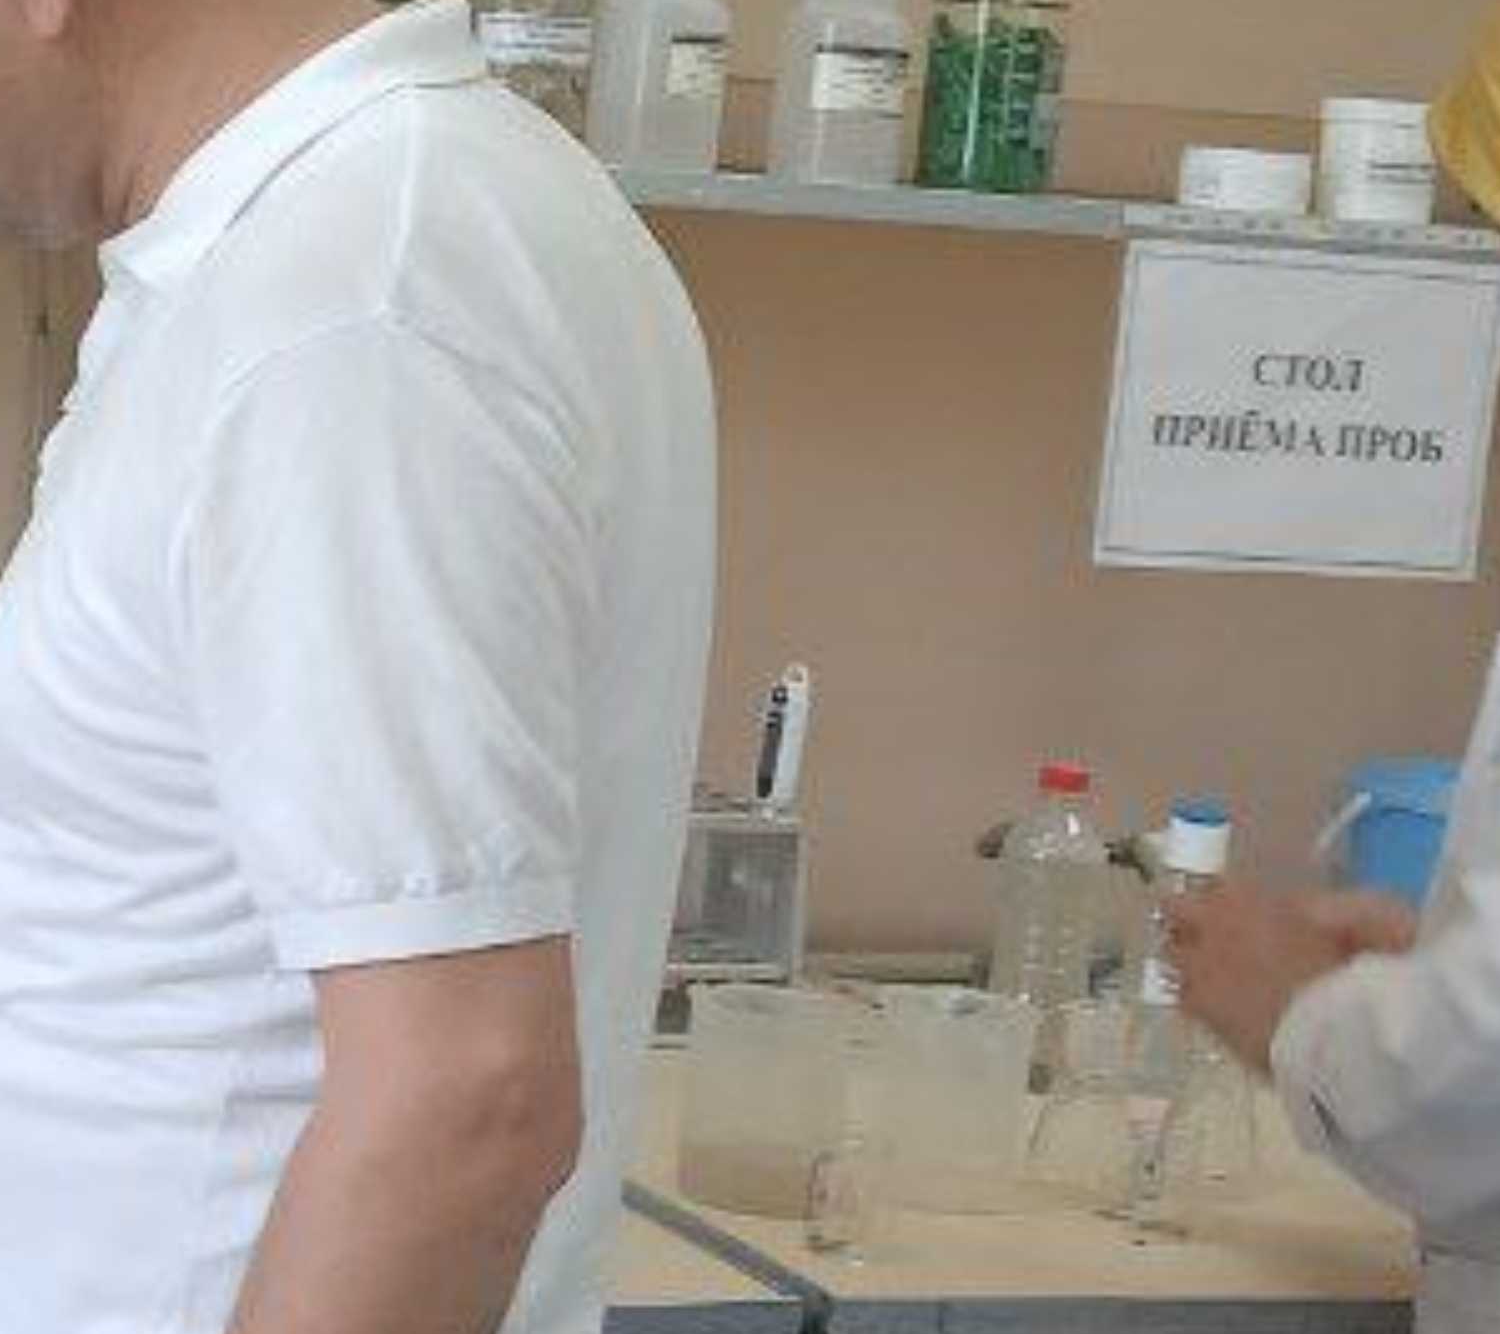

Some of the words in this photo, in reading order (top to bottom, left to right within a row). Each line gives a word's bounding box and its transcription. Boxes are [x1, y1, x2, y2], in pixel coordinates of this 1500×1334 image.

[1253, 353, 1366, 393] СТОЛ
[1152, 410, 1326, 458] ПРИЁМА
[1335, 424, 1445, 464] ПРОБ
